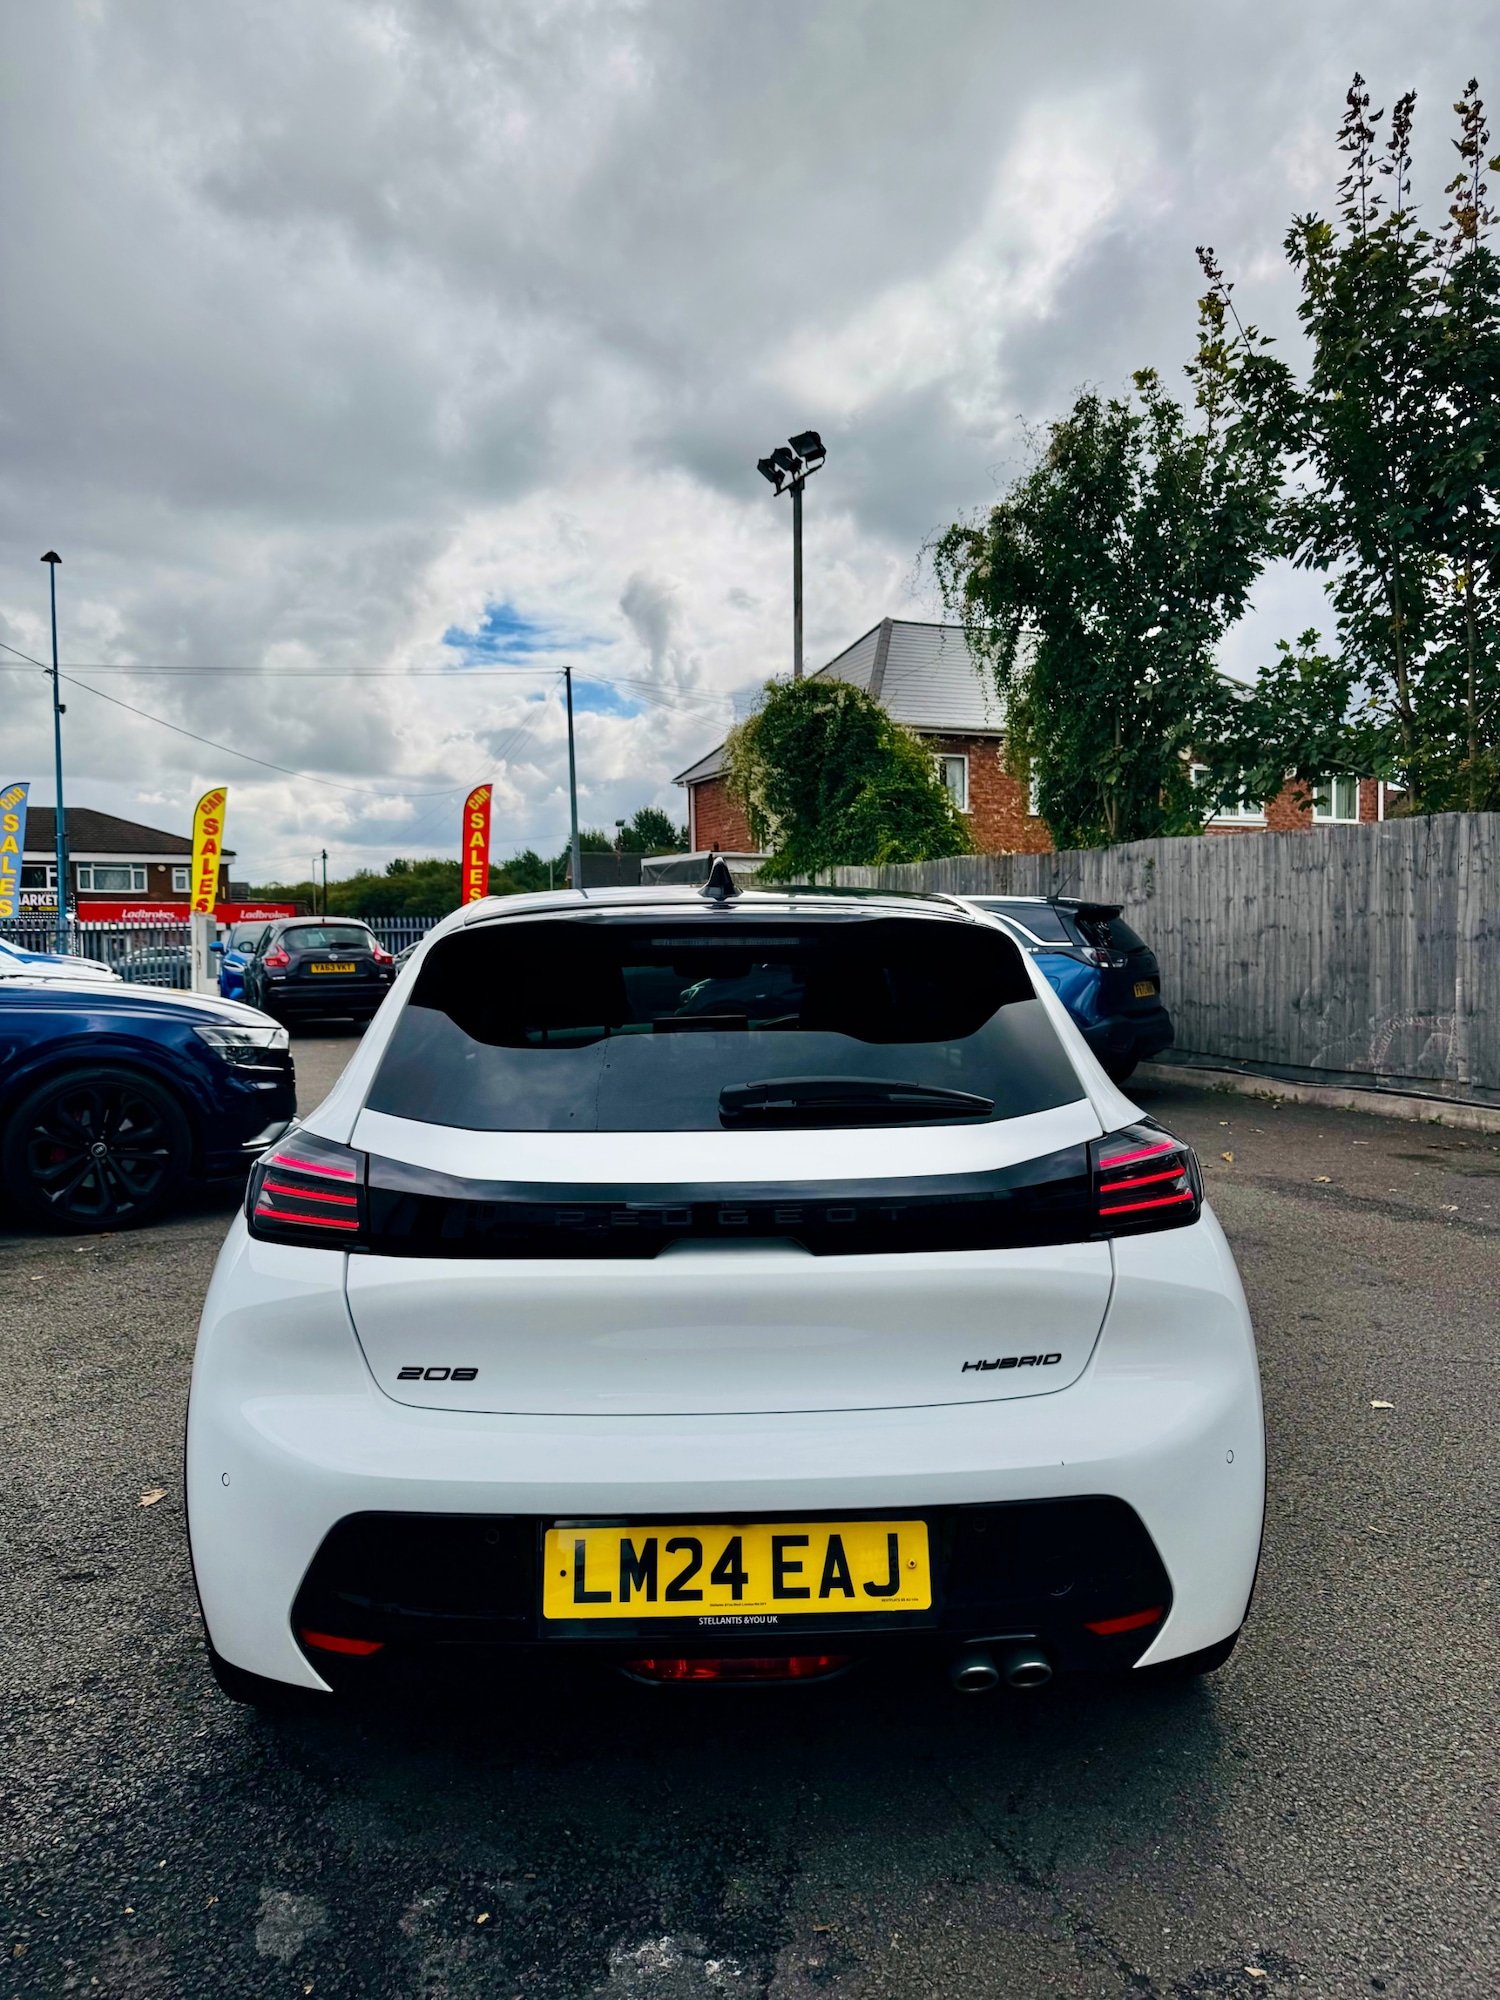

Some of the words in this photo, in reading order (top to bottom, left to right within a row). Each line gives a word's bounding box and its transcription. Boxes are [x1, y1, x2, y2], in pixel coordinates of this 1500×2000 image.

[0, 787, 26, 811] CAR
[200, 792, 225, 815] CAR
[467, 788, 490, 810] CAR
[0, 813, 19, 917] SALES
[196, 818, 219, 912] SALES
[469, 812, 485, 903] SALES
[122, 909, 175, 919] Ladbrokes
[240, 910, 289, 919] Ladbrokes
[555, 1206, 908, 1226] PEUGEOT
[396, 1366, 479, 1381] 208
[961, 1352, 1062, 1373] HYBRID
[573, 1536, 749, 1604] LM24
[772, 1533, 900, 1599] EAJ
[698, 1616, 743, 1626] STELLANTIS
[766, 1615, 779, 1624] UK
